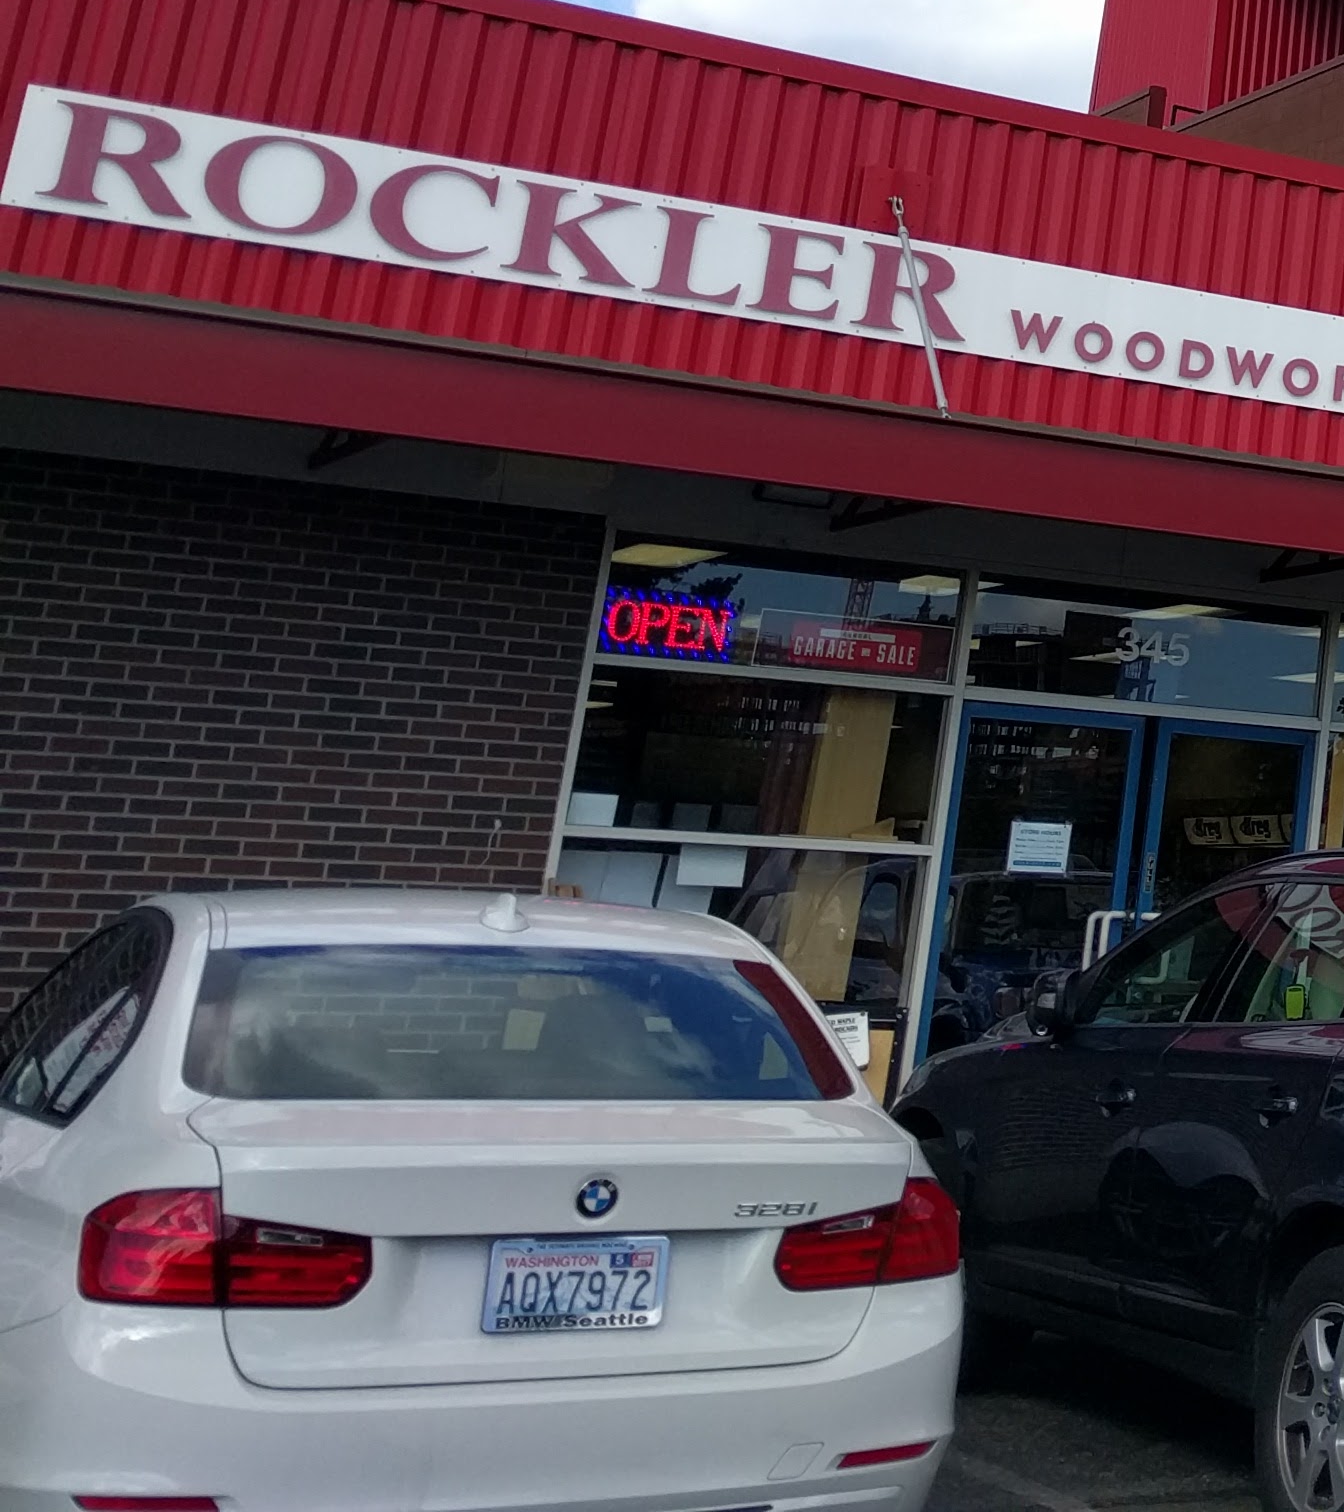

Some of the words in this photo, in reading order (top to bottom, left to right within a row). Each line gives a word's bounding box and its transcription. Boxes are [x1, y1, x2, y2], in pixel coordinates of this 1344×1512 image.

[35, 99, 967, 342] ROCKLER
[606, 599, 731, 653] OPEN
[1115, 626, 1191, 666] 345
[793, 636, 857, 661] GARAGE
[876, 644, 916, 666] SALE
[505, 1255, 599, 1268] WASHINGTON
[496, 1270, 651, 1315] AQX7972
[495, 1316, 554, 1330] BMW
[563, 1313, 648, 1328] Seattle
